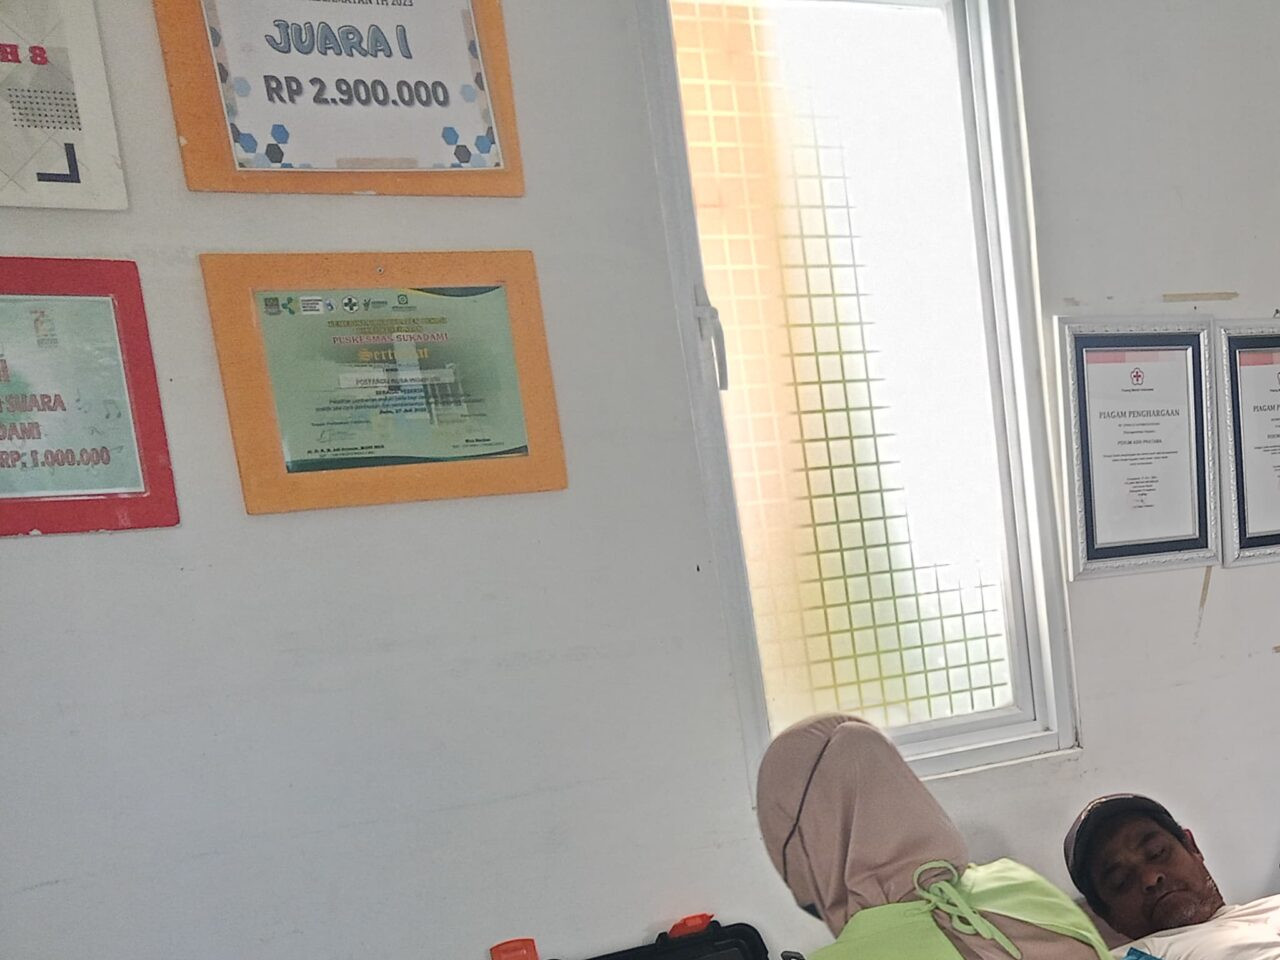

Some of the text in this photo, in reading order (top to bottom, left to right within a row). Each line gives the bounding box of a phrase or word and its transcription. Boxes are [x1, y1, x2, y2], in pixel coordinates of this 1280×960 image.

[264, 19, 393, 58] JUARA
[263, 74, 450, 107] RP 2.900.000
[333, 332, 449, 344] PUSKESMAS SUKADAMI
[1099, 408, 1180, 419] PIAGAM PENGHARGAAN
[1253, 404, 1276, 413] PIAGAM
